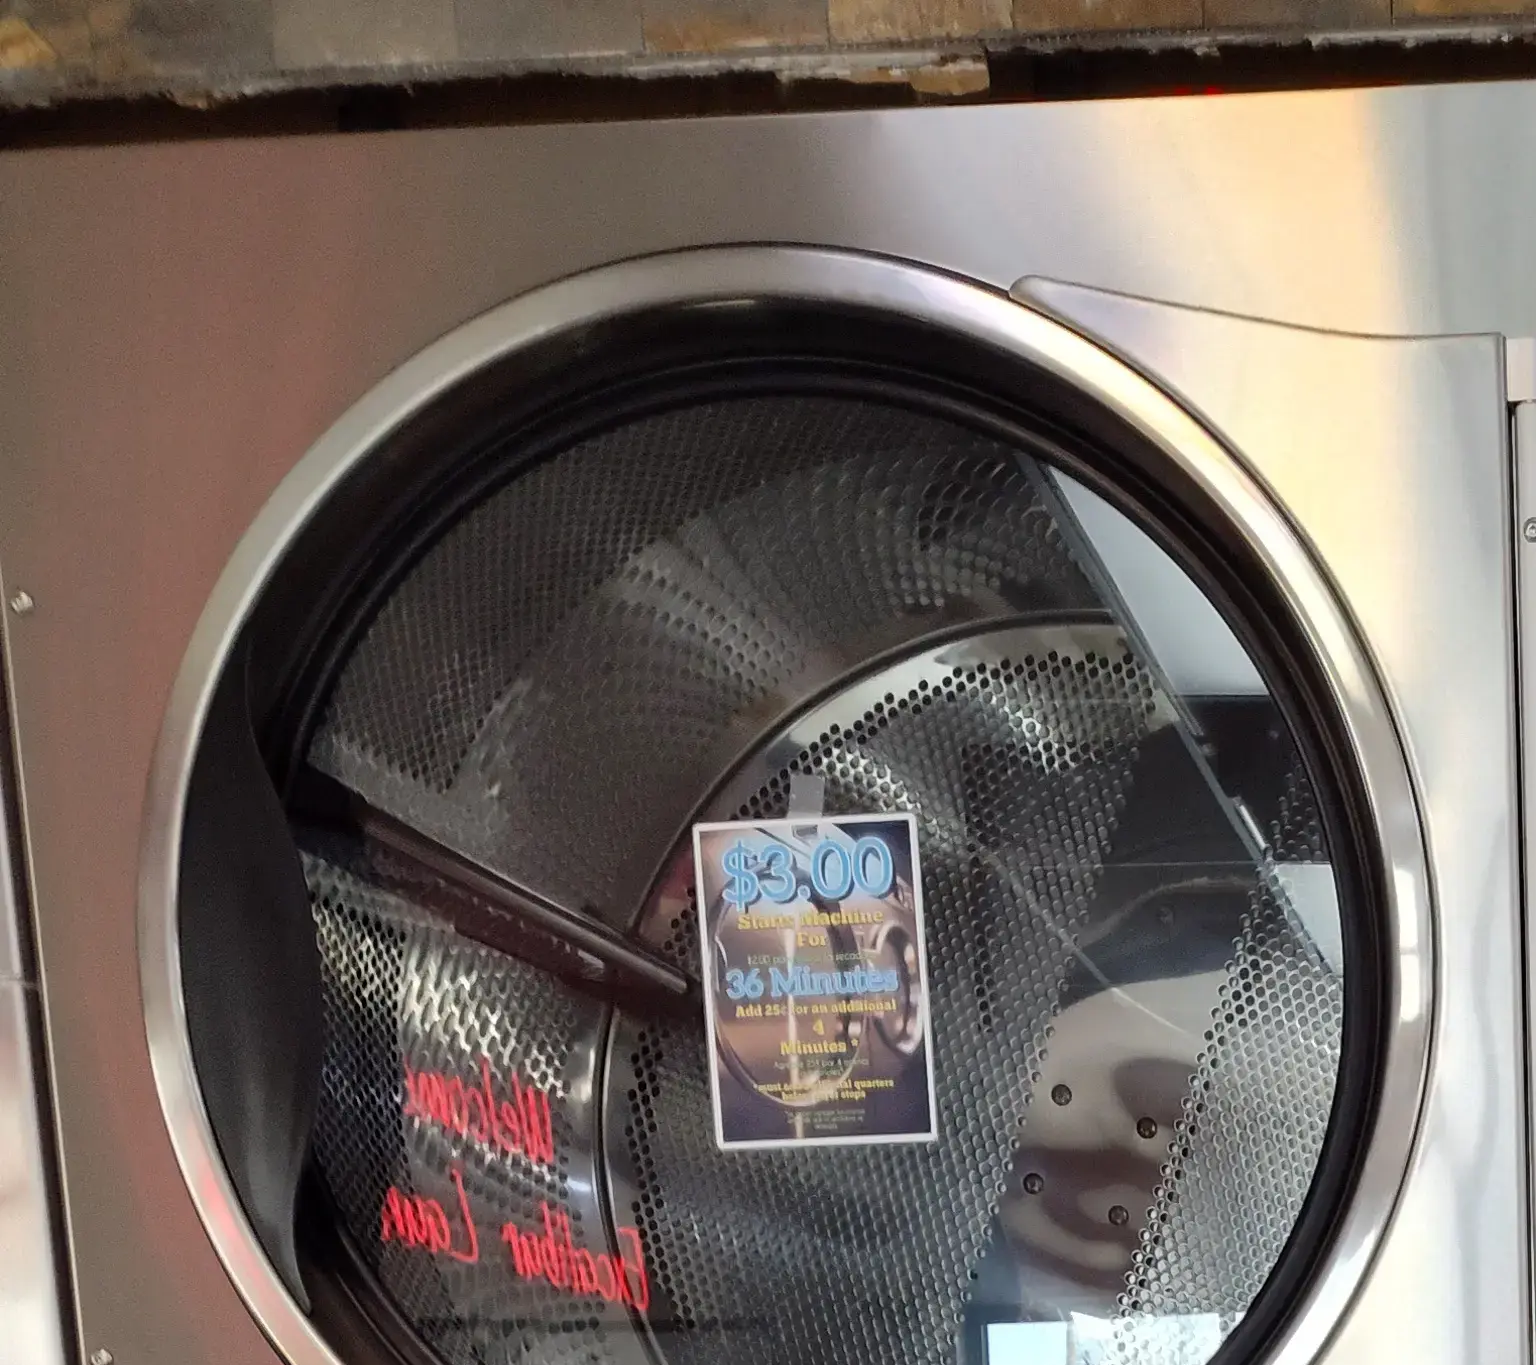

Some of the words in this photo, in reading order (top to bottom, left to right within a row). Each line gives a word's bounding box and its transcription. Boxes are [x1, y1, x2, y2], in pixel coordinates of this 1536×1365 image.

[721, 836, 894, 912] $3.00
[738, 914, 794, 930] Starts
[801, 909, 884, 927] Machine
[797, 933, 828, 947] For
[725, 967, 764, 999] 36
[769, 964, 899, 998] Minutes
[735, 1004, 762, 1018] Add
[811, 1003, 828, 1014] an
[830, 999, 897, 1013] additional
[812, 1019, 825, 1035] 4
[780, 1040, 847, 1056] Minutes
[854, 1079, 894, 1092] quarters
